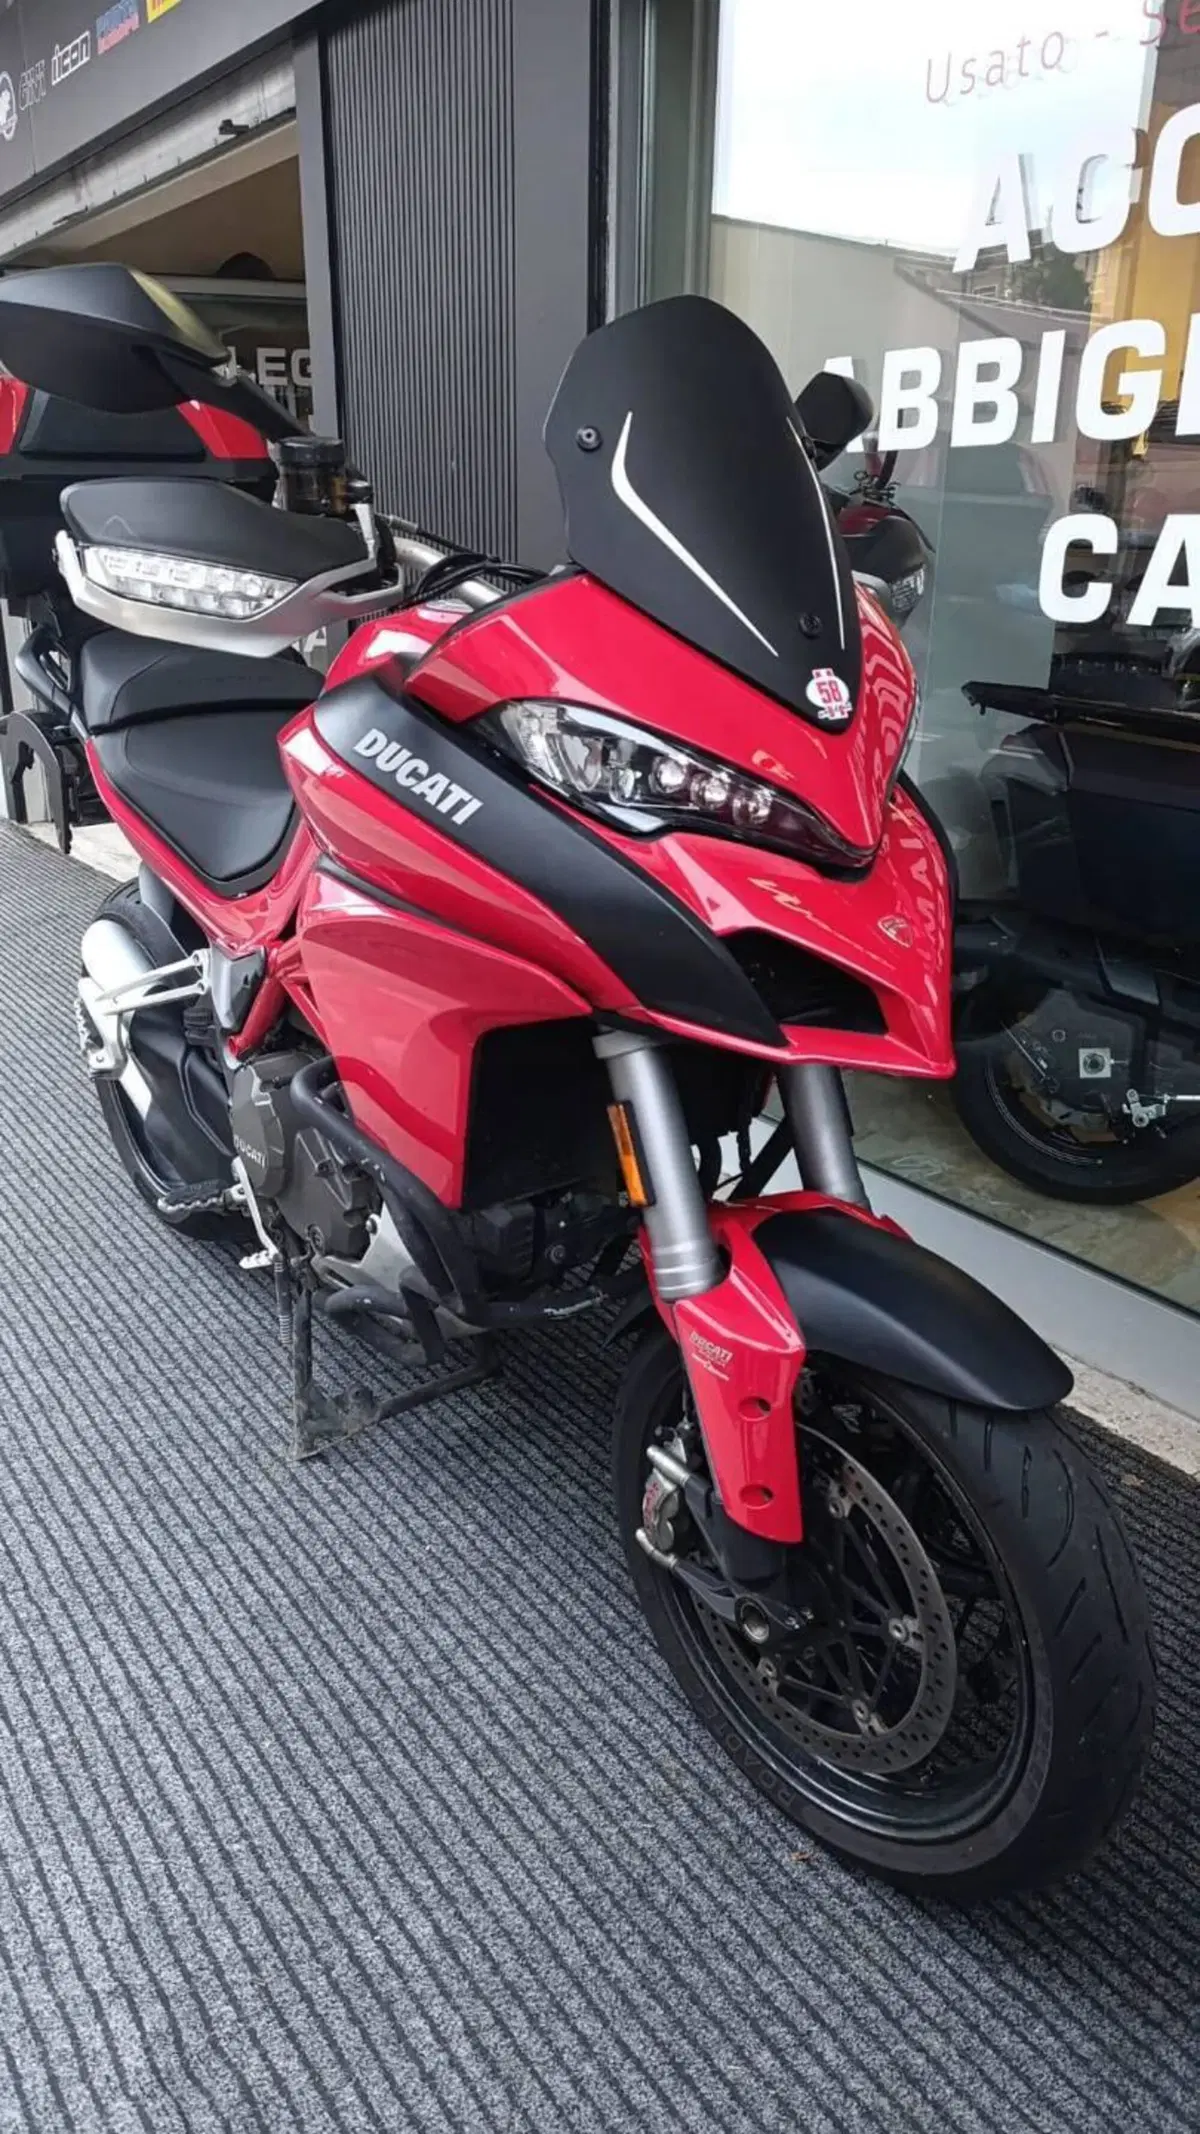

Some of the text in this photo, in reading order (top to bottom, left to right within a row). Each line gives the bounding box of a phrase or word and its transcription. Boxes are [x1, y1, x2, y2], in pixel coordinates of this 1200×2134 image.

[926, 31, 1064, 103] Usato
[1038, 513, 1200, 629] CA
[815, 680, 843, 704] 58
[353, 728, 484, 825] DUCATI
[233, 1134, 266, 1169] DUCATI
[689, 1331, 733, 1363] DUCATI
